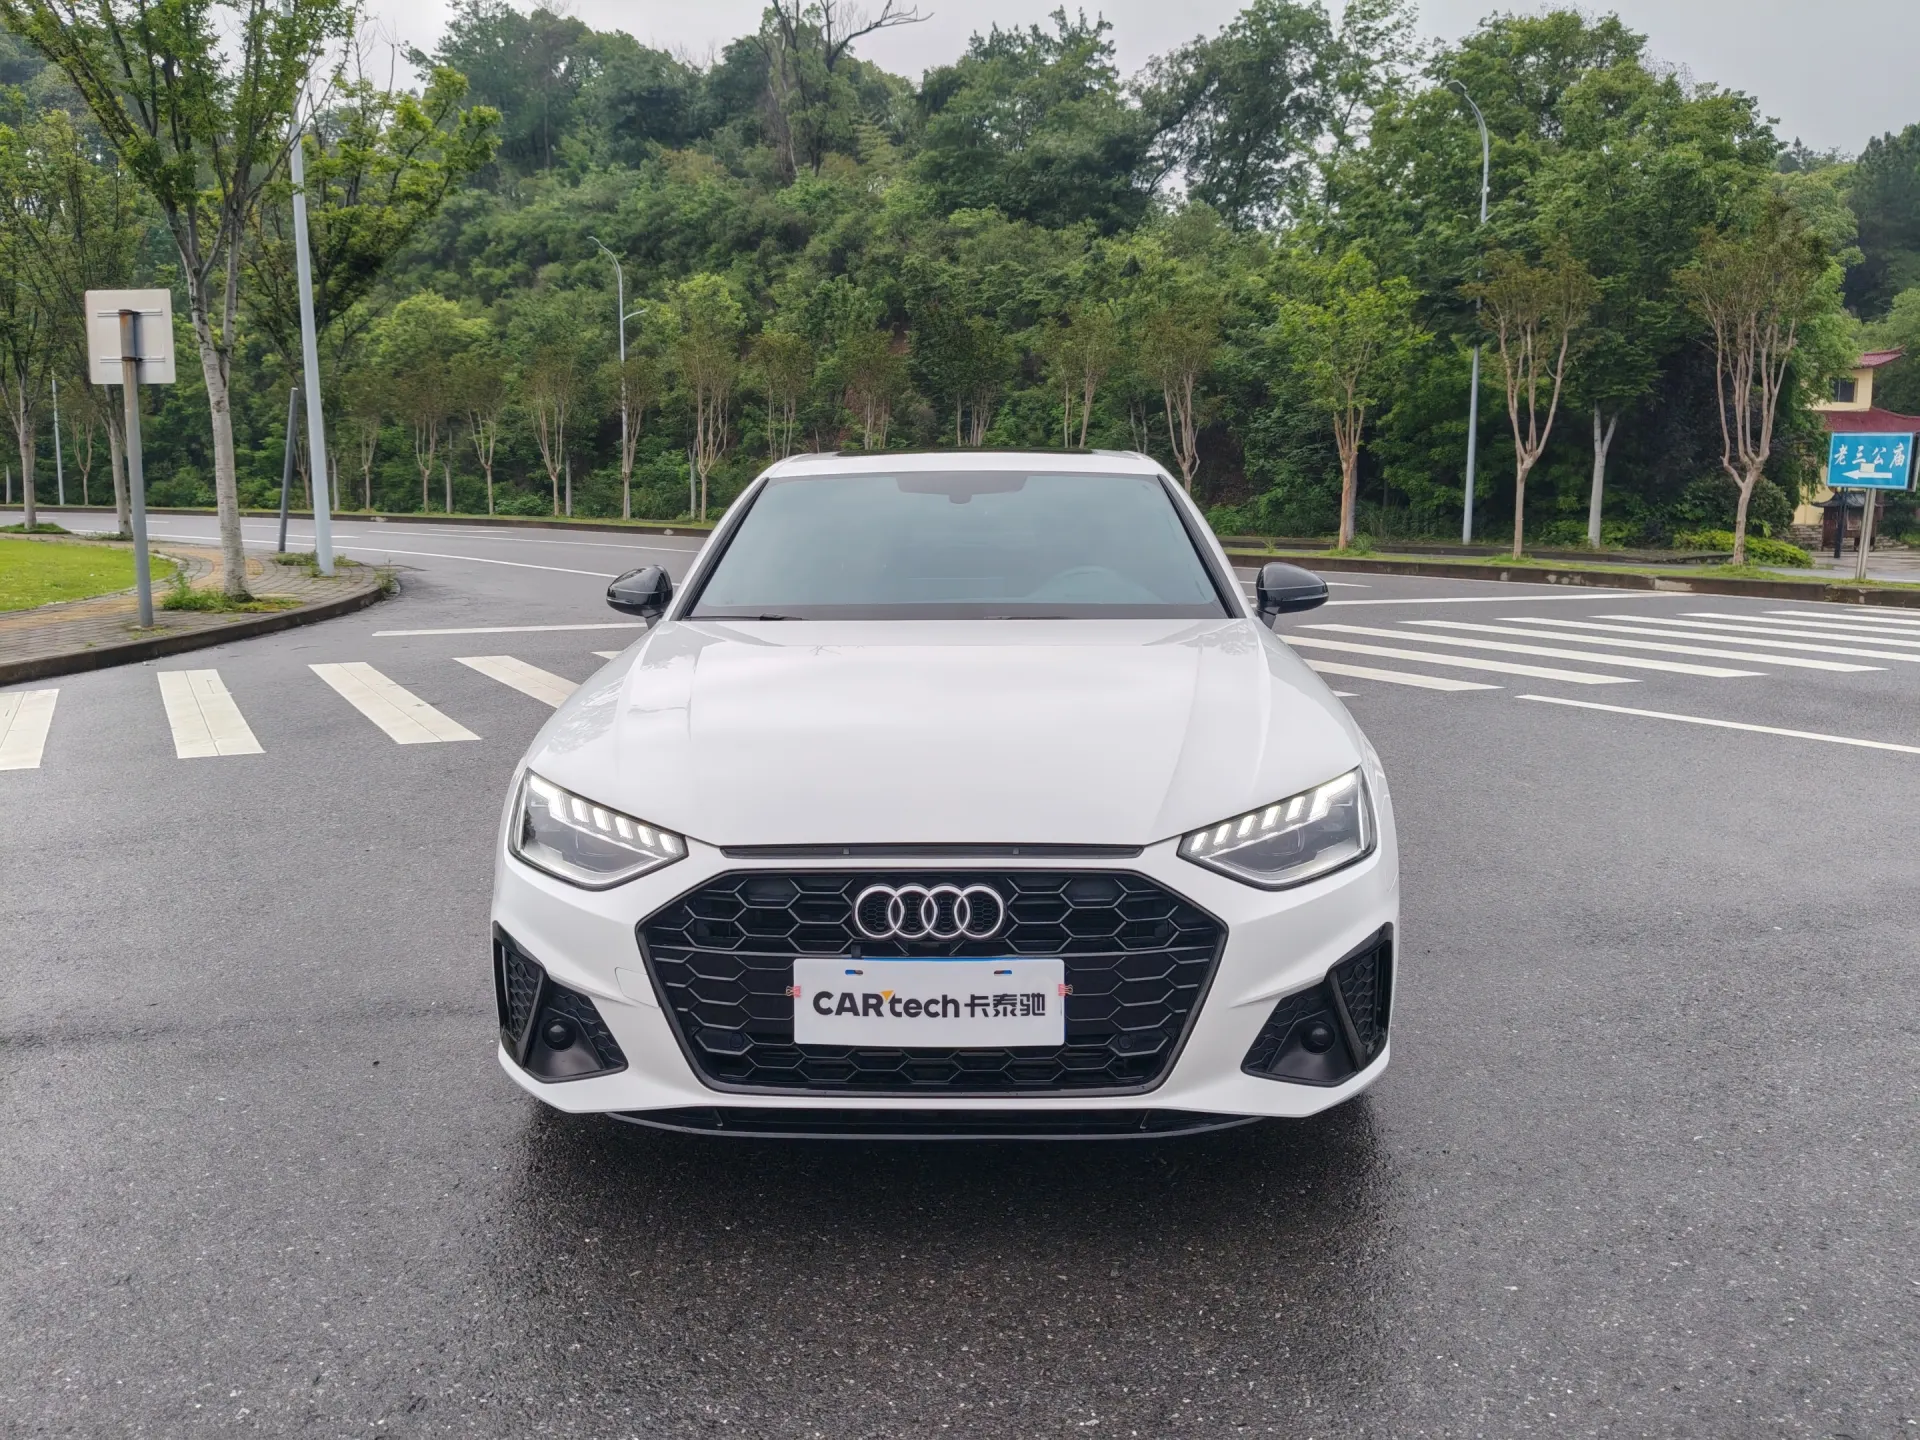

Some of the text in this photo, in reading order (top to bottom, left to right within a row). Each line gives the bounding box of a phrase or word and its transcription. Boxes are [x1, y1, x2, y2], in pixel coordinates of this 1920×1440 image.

[812, 990, 1046, 1018] CARtech 卡泰驰
